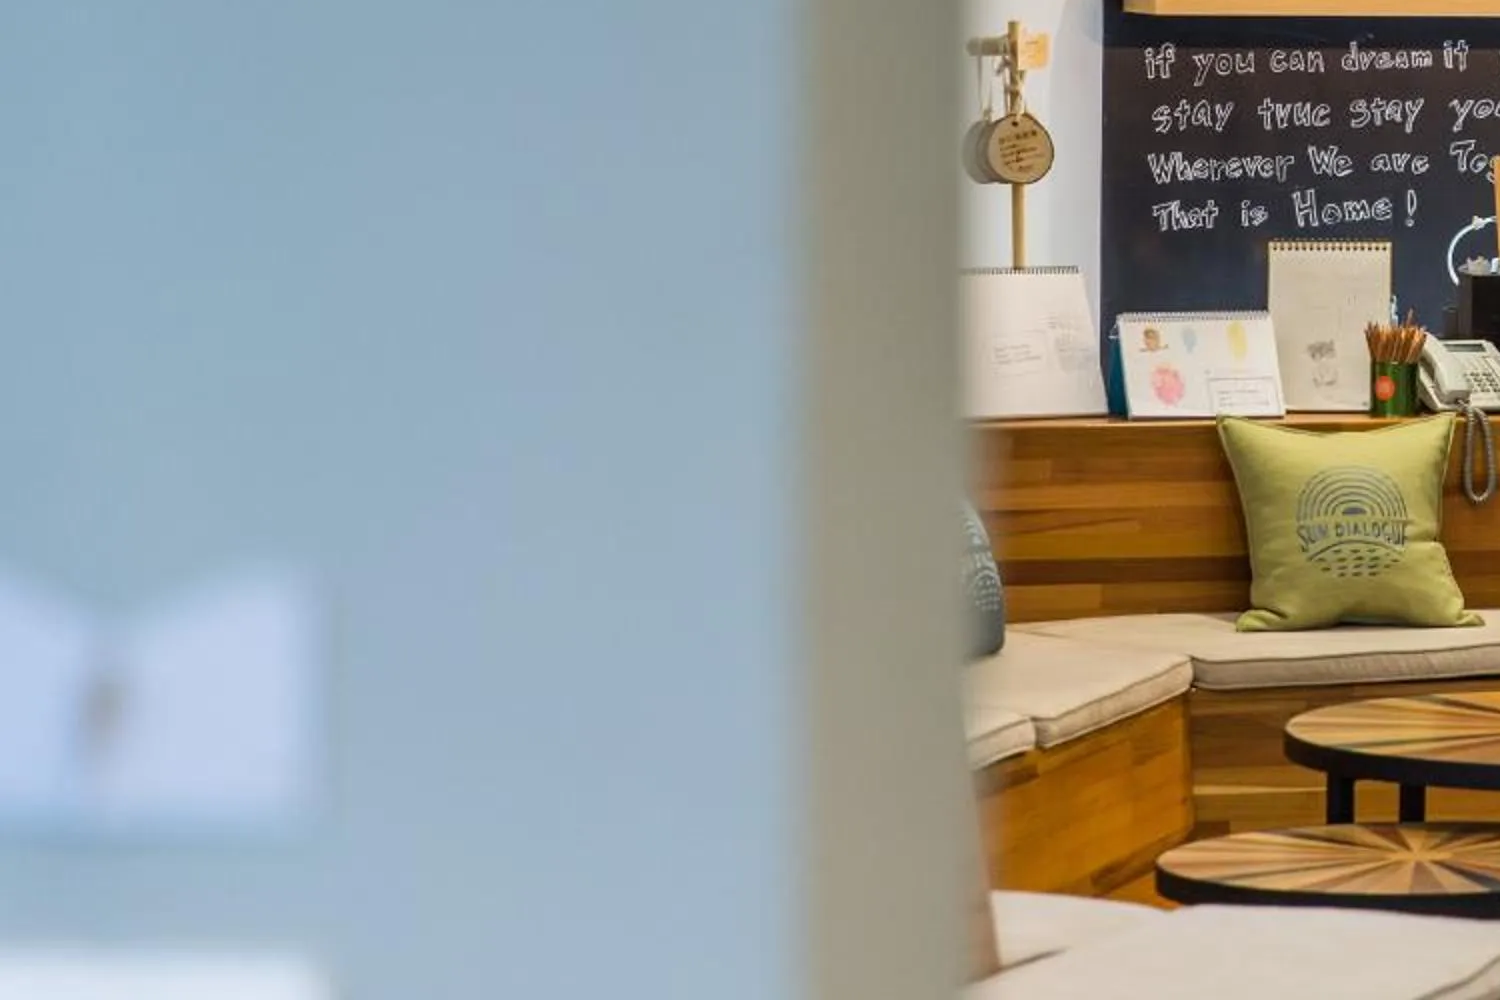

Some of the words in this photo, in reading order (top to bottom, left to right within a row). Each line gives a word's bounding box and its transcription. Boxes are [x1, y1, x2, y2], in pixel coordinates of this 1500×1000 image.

[1192, 49, 1255, 86] you
[1269, 49, 1325, 72] can
[1342, 41, 1433, 71] dream
[1443, 40, 1469, 71] it
[1151, 100, 1234, 133] stay
[1257, 98, 1332, 130] true
[1148, 151, 1294, 184] Wherever
[1308, 145, 1353, 177] We
[1370, 153, 1431, 175] are
[1152, 200, 1220, 232] That
[1240, 201, 1269, 227] is
